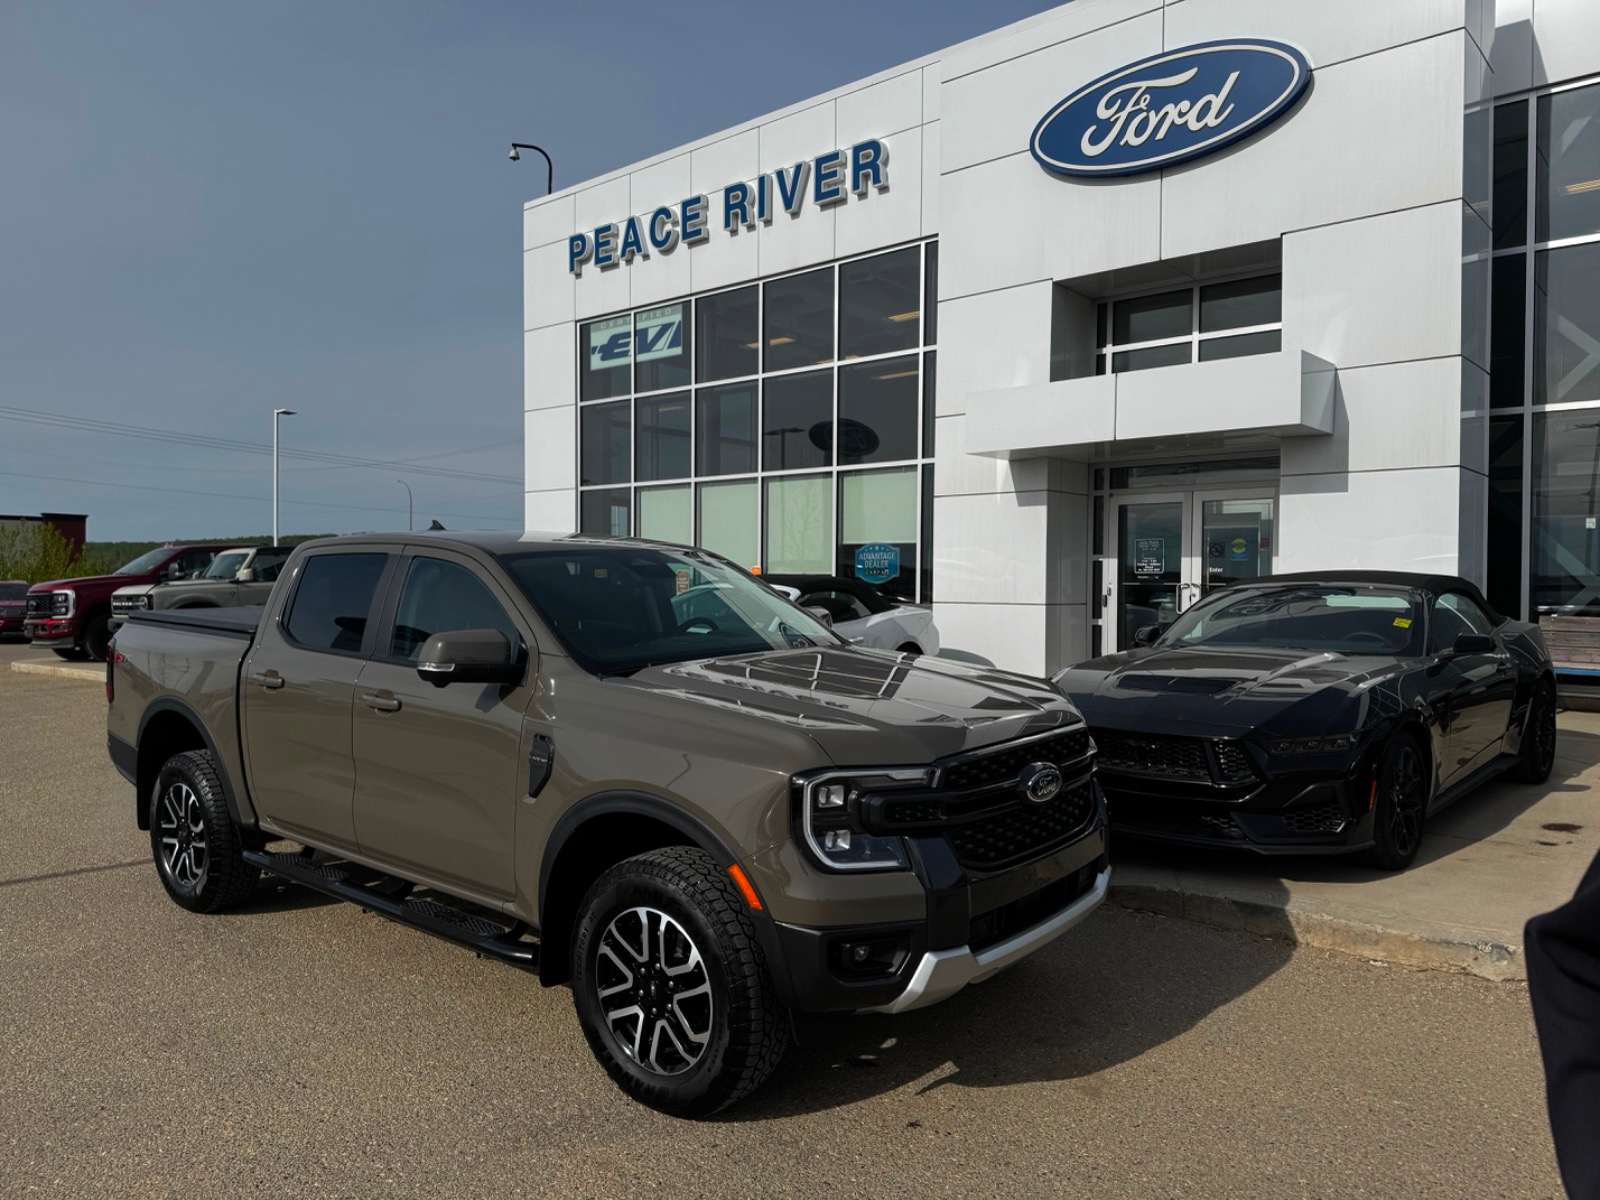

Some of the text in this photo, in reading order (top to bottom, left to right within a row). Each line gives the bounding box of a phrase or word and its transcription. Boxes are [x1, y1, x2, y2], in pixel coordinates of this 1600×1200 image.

[1080, 67, 1240, 157] Ford
[568, 138, 889, 276] PEACE RIVER
[858, 551, 896, 560] ADVANTAGE
[864, 560, 889, 568] DEALER
